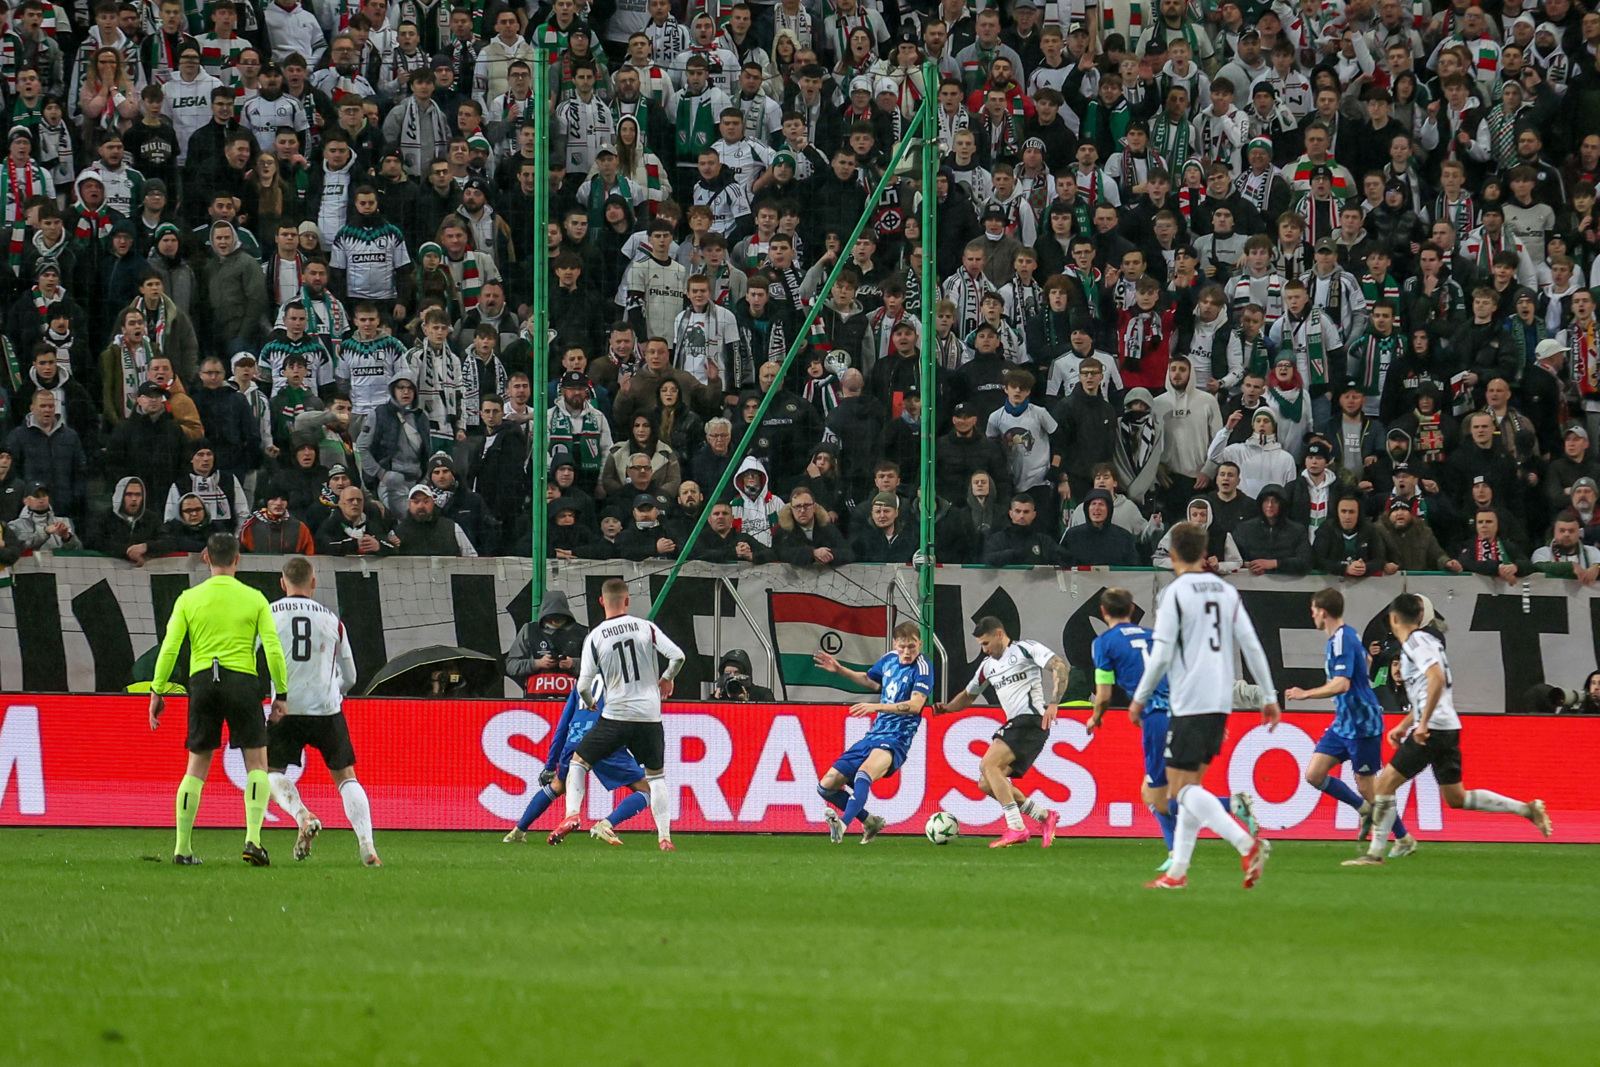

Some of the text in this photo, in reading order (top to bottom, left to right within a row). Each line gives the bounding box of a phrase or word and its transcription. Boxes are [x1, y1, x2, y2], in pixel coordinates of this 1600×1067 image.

[172, 95, 208, 109] LEGIA
[353, 254, 385, 263] CANAL+
[649, 288, 684, 298] Plus500
[353, 368, 384, 376] CANAL+
[601, 622, 640, 639] CHODYNA
[1205, 601, 1221, 652] 3
[291, 616, 311, 662] 8
[612, 638, 640, 683] 11
[535, 677, 577, 692] PHOT
